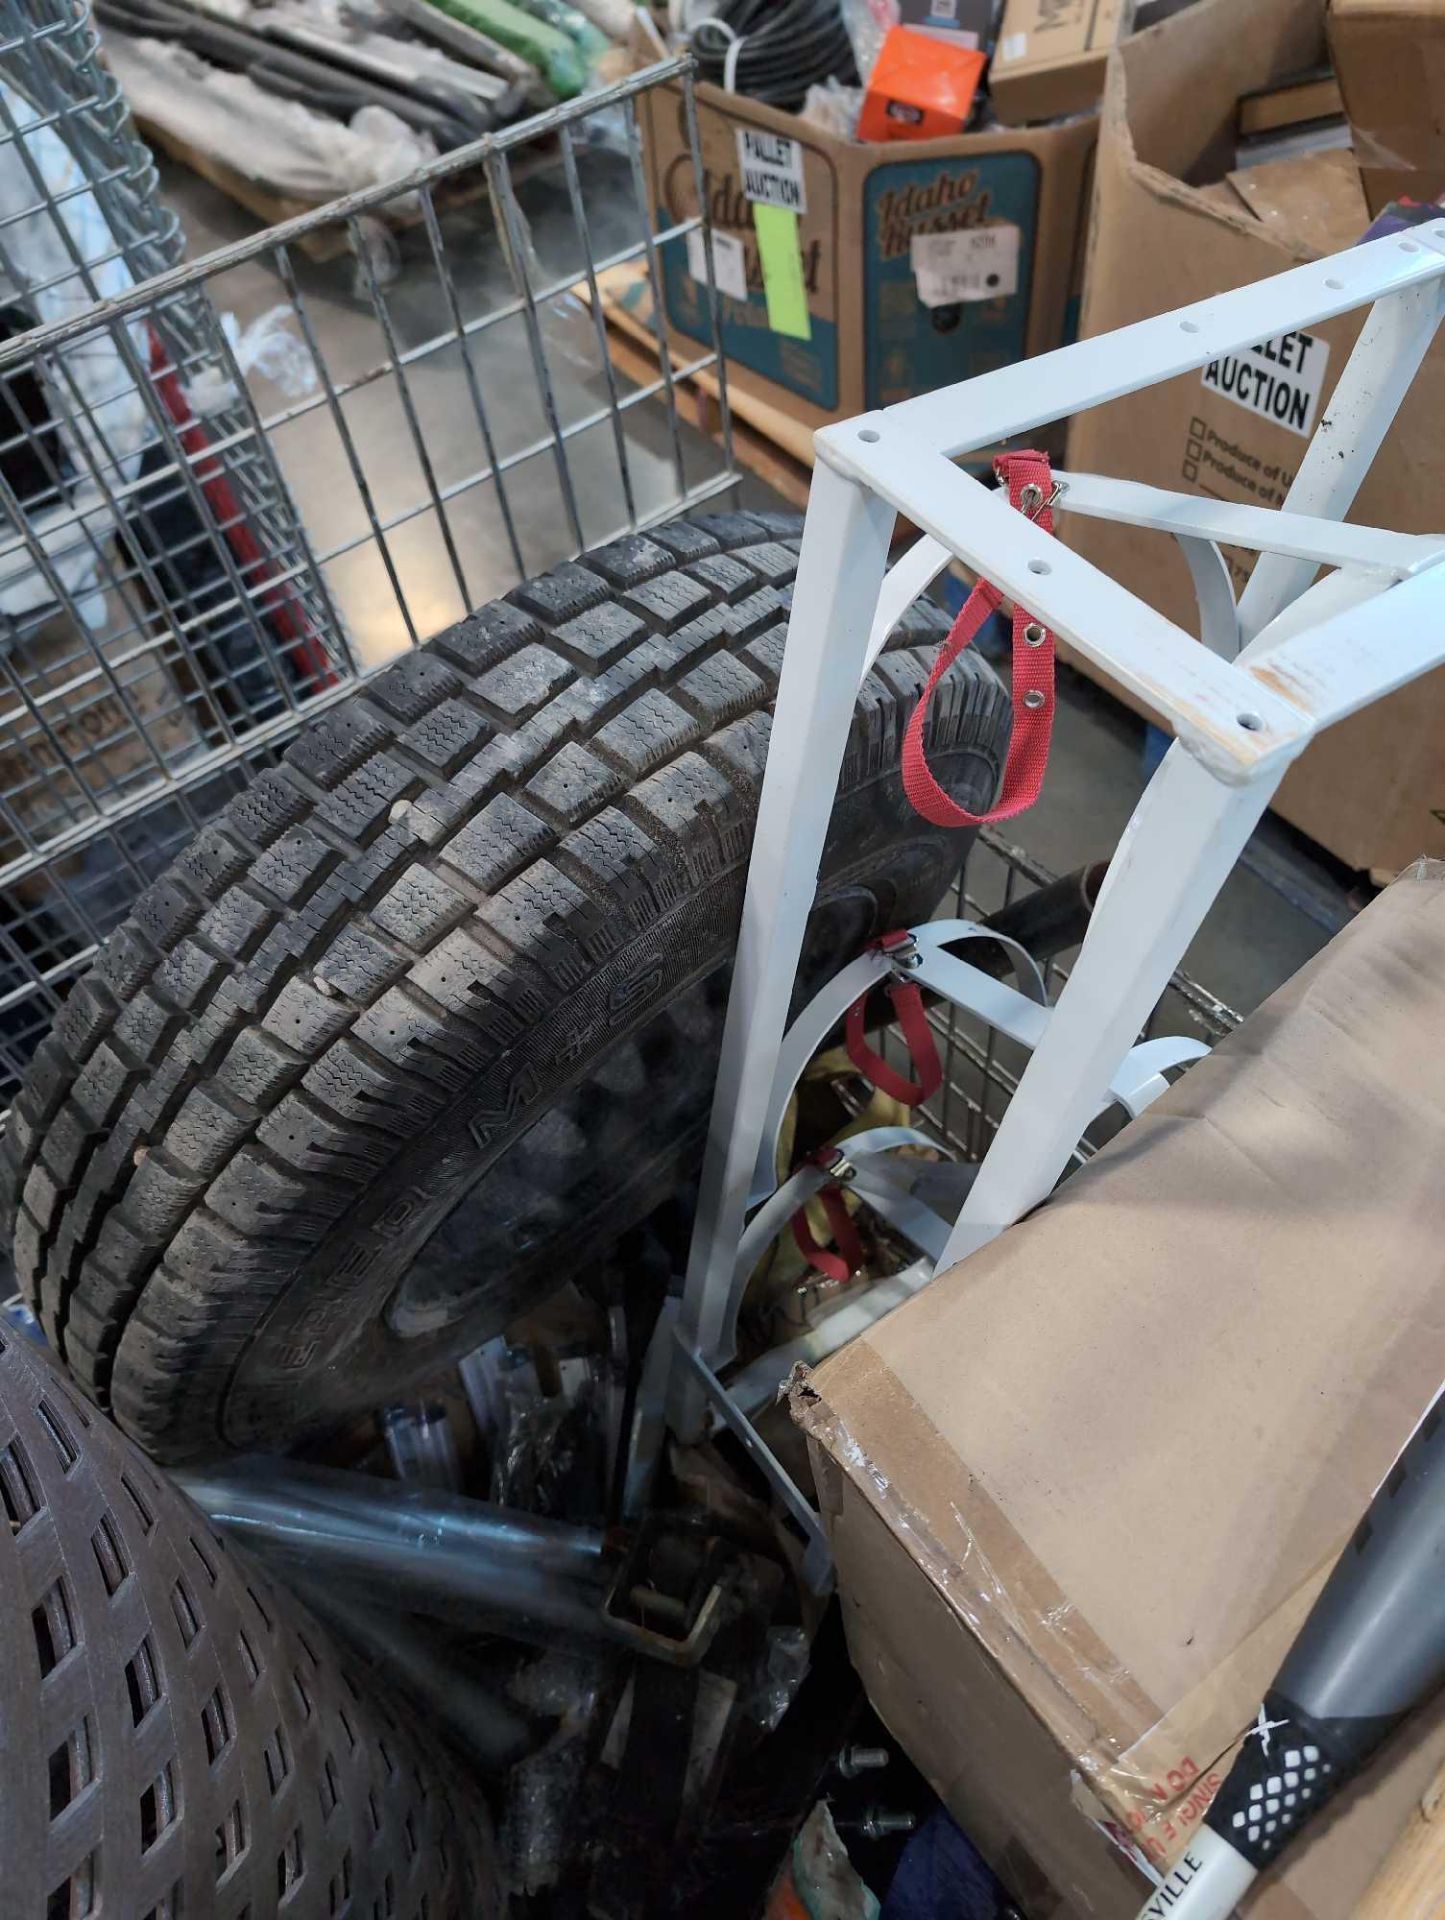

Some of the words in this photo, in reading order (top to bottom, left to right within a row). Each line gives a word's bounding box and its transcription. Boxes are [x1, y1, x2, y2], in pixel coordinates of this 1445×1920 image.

[744, 168, 800, 207] AUCTION
[876, 169, 978, 228] Idaho
[1204, 355, 1311, 430] AUCTION
[1201, 450, 1257, 493] Produce
[1258, 485, 1275, 502] of
[1206, 429, 1262, 472] Produce
[1263, 463, 1280, 482] of
